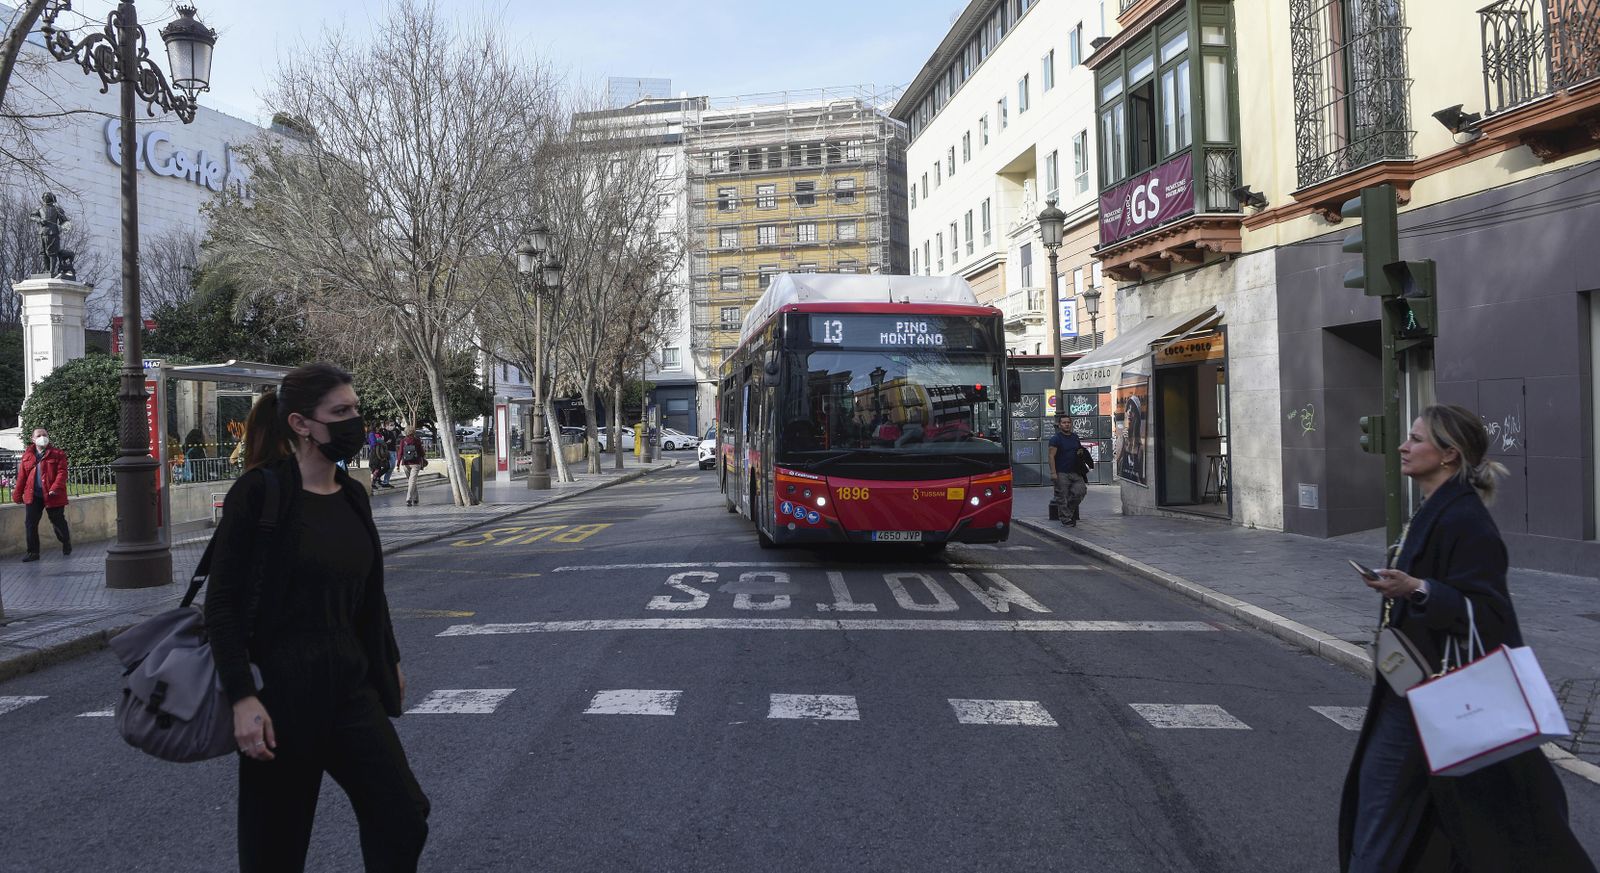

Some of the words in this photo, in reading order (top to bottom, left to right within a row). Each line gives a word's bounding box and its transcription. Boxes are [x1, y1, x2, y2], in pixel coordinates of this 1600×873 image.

[1131, 178, 1160, 224] GS
[823, 320, 843, 344] 13
[896, 321, 928, 334] PINO
[880, 333, 943, 345] MONTANO
[1164, 346, 1185, 356] LOCO
[1190, 342, 1212, 353] POLO
[1072, 370, 1089, 382] LOCO
[1094, 368, 1111, 378] POLO
[836, 487, 870, 500] 1896
[451, 523, 615, 548] BUS
[878, 532, 900, 541] 4650
[903, 532, 921, 541] JVP
